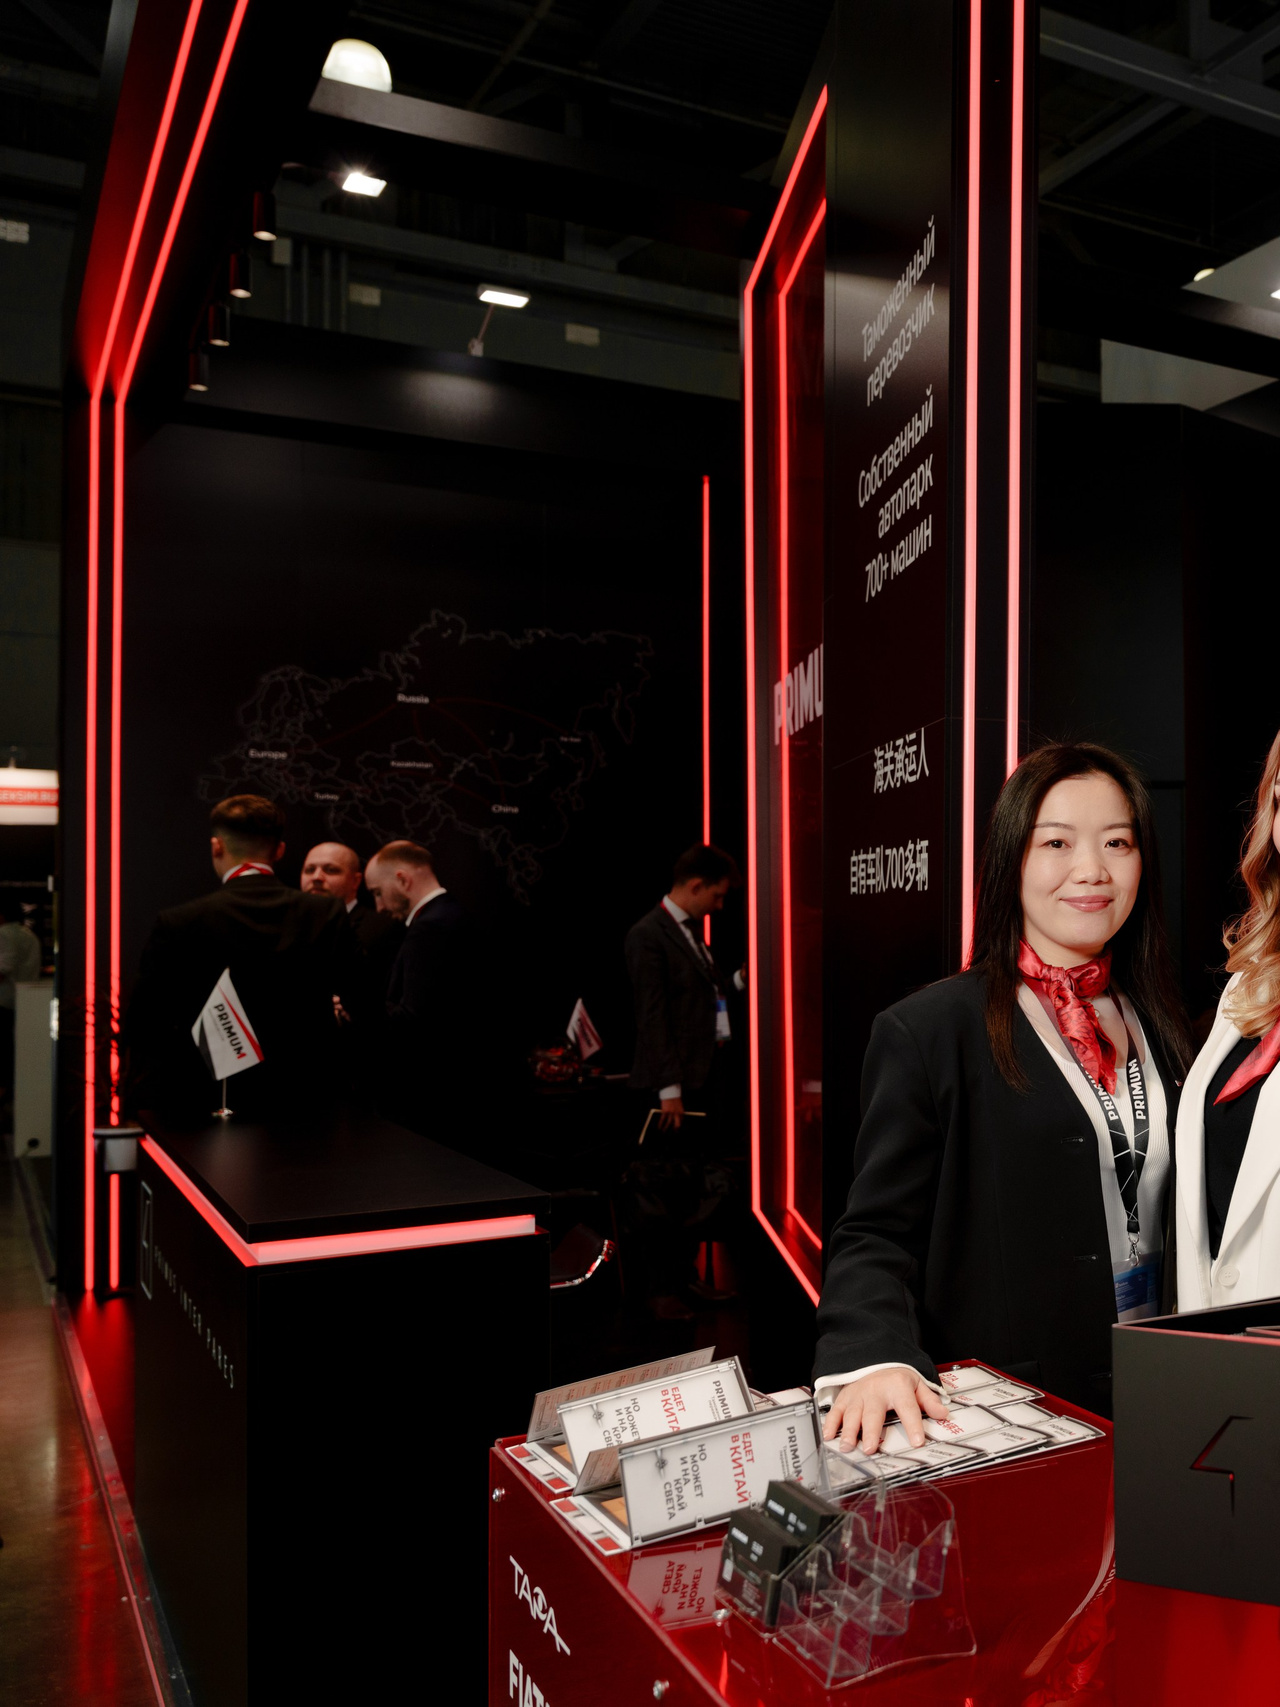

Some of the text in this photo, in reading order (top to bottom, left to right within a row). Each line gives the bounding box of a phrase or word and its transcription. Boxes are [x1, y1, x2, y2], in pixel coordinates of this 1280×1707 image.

[861, 214, 935, 362] Таможенный
[866, 283, 936, 407] перевозчик
[858, 383, 934, 508] Собственный
[877, 453, 934, 539] автопарк
[864, 513, 932, 603] 700+ машин
[396, 691, 430, 705] Russia
[248, 747, 288, 762] Europe
[873, 727, 930, 794] 海关承运人
[491, 803, 520, 815] China
[849, 838, 930, 895] 自有车队700多辆
[213, 1003, 247, 1060] PRIMUM
[1127, 1058, 1147, 1120] PRIMUM
[205, 1327, 236, 1390] PARES
[629, 1396, 641, 1413] НО
[660, 1388, 669, 1398] В
[670, 1386, 687, 1413] ЕДЕТ
[614, 1407, 627, 1433] И НА
[697, 1443, 707, 1461] НО
[741, 1431, 755, 1464] ЕДЕТ
[679, 1456, 691, 1486] И НА
[689, 1454, 704, 1498] МОЖЕТ
[728, 1433, 753, 1505] В КИТАЙ
[662, 1481, 677, 1521] СВЕТА
[673, 1478, 688, 1512] КРАЙ
